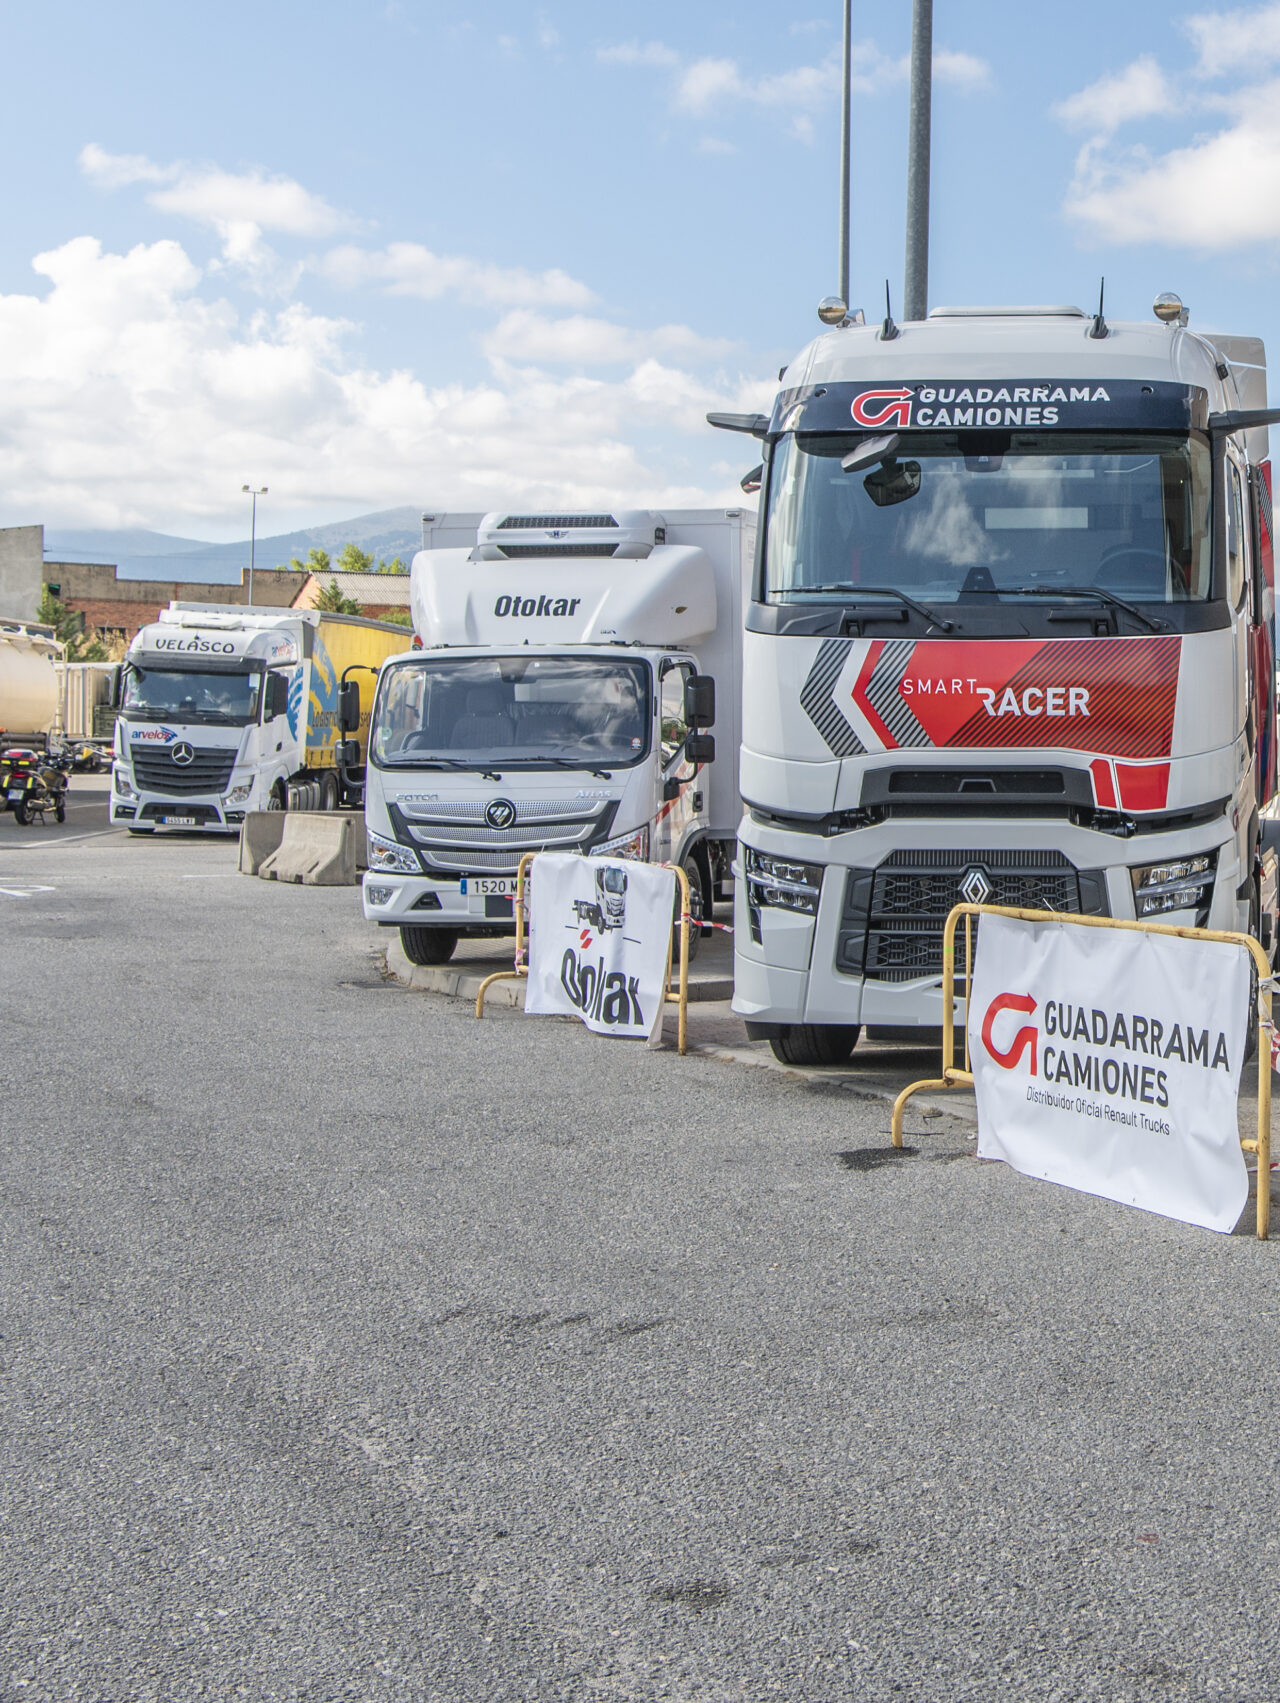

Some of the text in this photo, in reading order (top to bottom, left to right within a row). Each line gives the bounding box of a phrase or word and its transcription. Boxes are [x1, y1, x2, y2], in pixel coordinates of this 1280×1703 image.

[919, 387, 1111, 403] GUADARRAMA
[916, 407, 1059, 426] CAMIONES
[494, 595, 581, 617] Otokar
[155, 639, 235, 653] VELASCO
[903, 679, 1091, 716] SMART RACER
[475, 881, 506, 893] 1520
[1045, 1000, 1230, 1072] GUADARRAMA
[1043, 1046, 1169, 1108] CAMIONES
[1026, 1086, 1170, 1136] Distribuidor Oficial Renault Trucks
